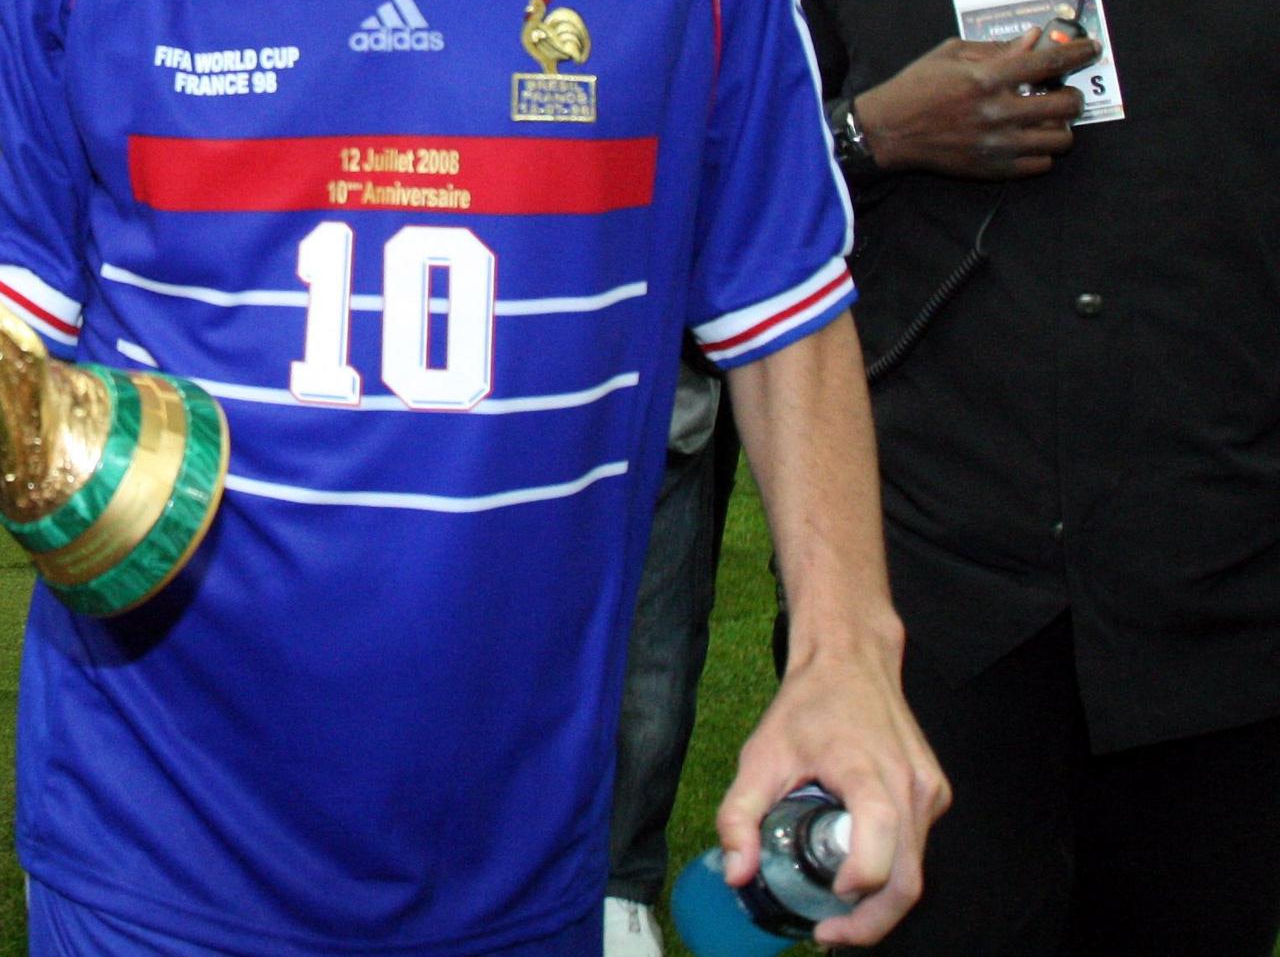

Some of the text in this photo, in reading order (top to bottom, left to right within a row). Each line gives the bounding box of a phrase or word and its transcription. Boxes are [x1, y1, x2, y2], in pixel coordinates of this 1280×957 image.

[349, 30, 445, 52] adidas
[154, 45, 300, 73] FIFA WORLD CUP
[174, 70, 278, 96] FRANCE 98
[1090, 75, 1106, 95] S
[340, 147, 460, 175] 12 Juillet 2008
[362, 180, 472, 210] Anniversaire
[289, 221, 497, 411] 10
